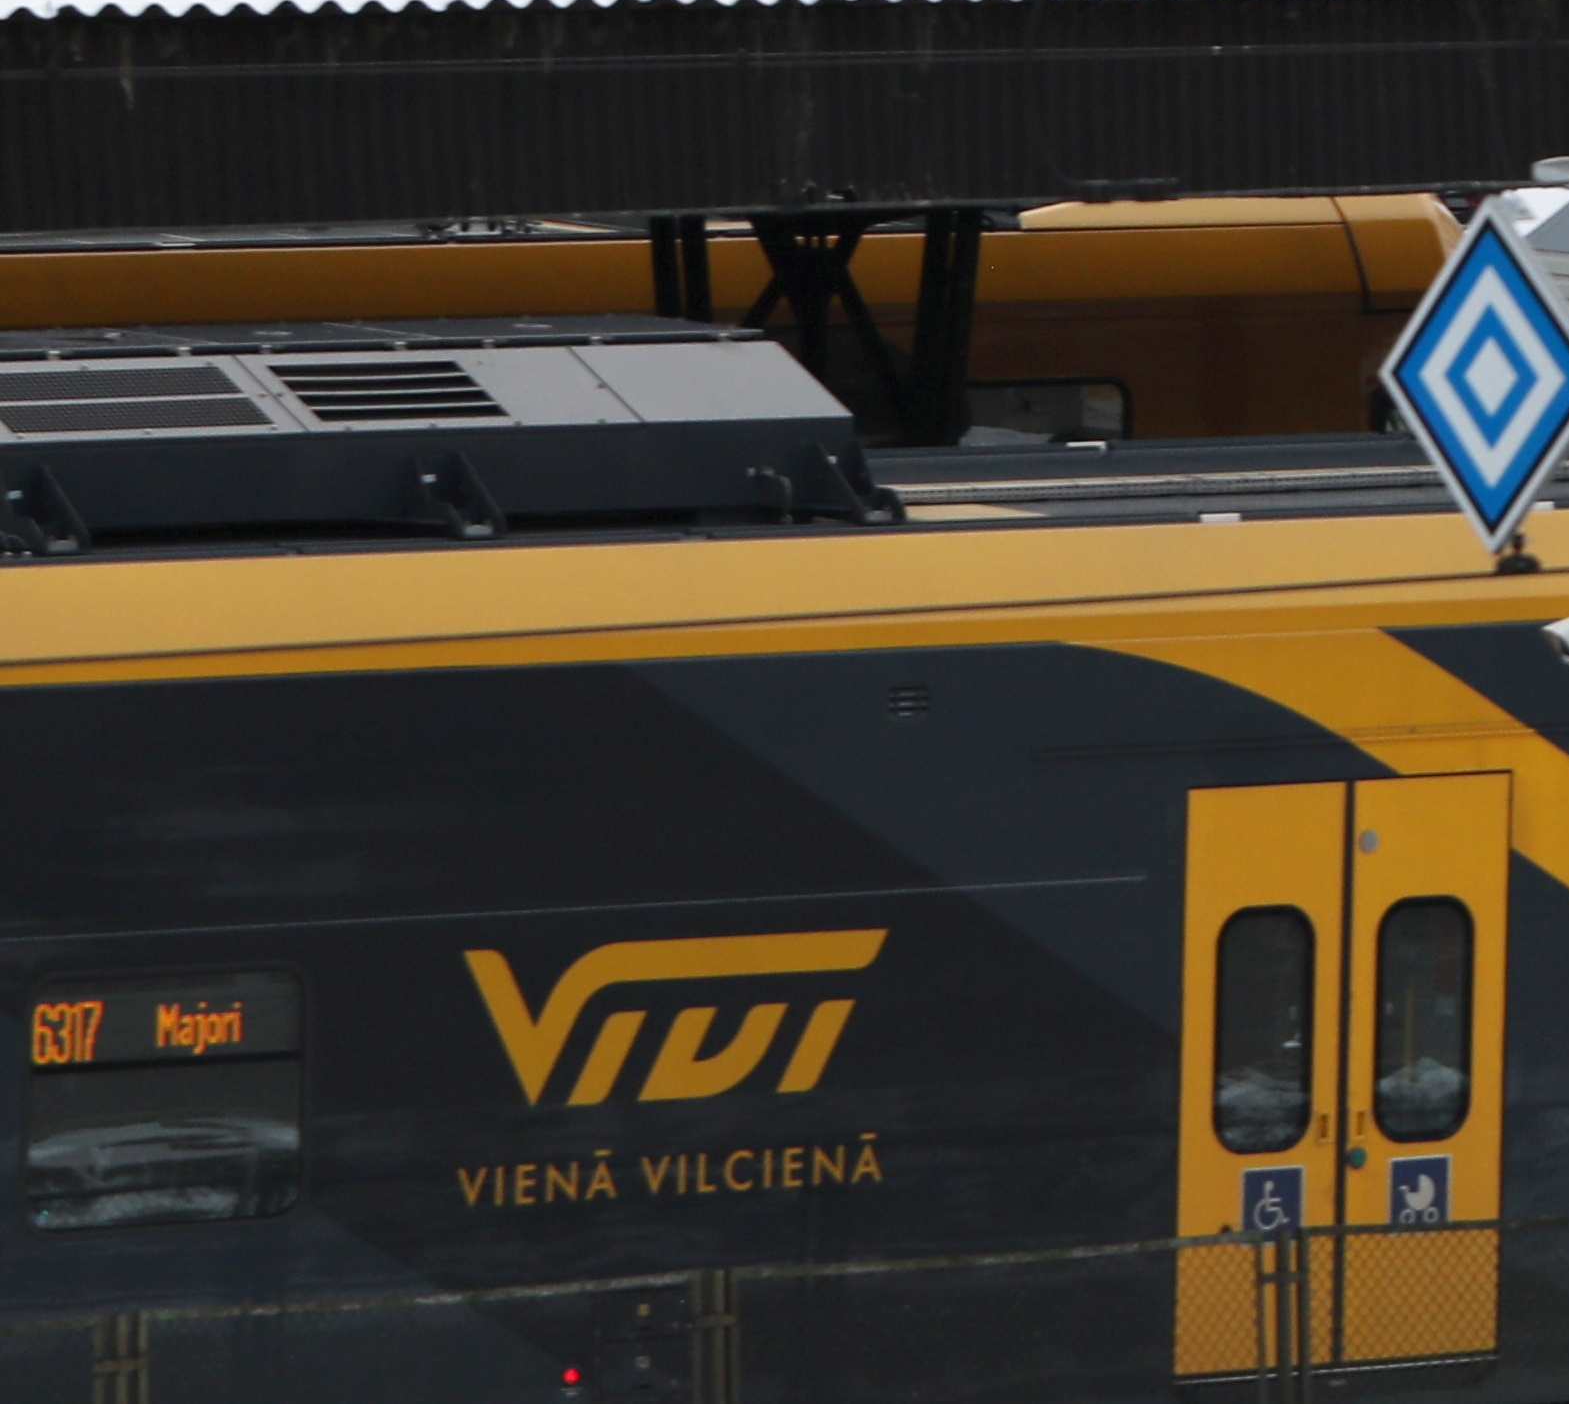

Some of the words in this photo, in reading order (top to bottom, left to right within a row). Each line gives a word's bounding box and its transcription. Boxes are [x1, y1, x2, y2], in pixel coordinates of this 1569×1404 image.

[32, 999, 104, 1063] 6317
[156, 1001, 243, 1055] Majori
[458, 1149, 617, 1206] VIENĀ
[640, 1132, 884, 1194] VILCIENĀ
